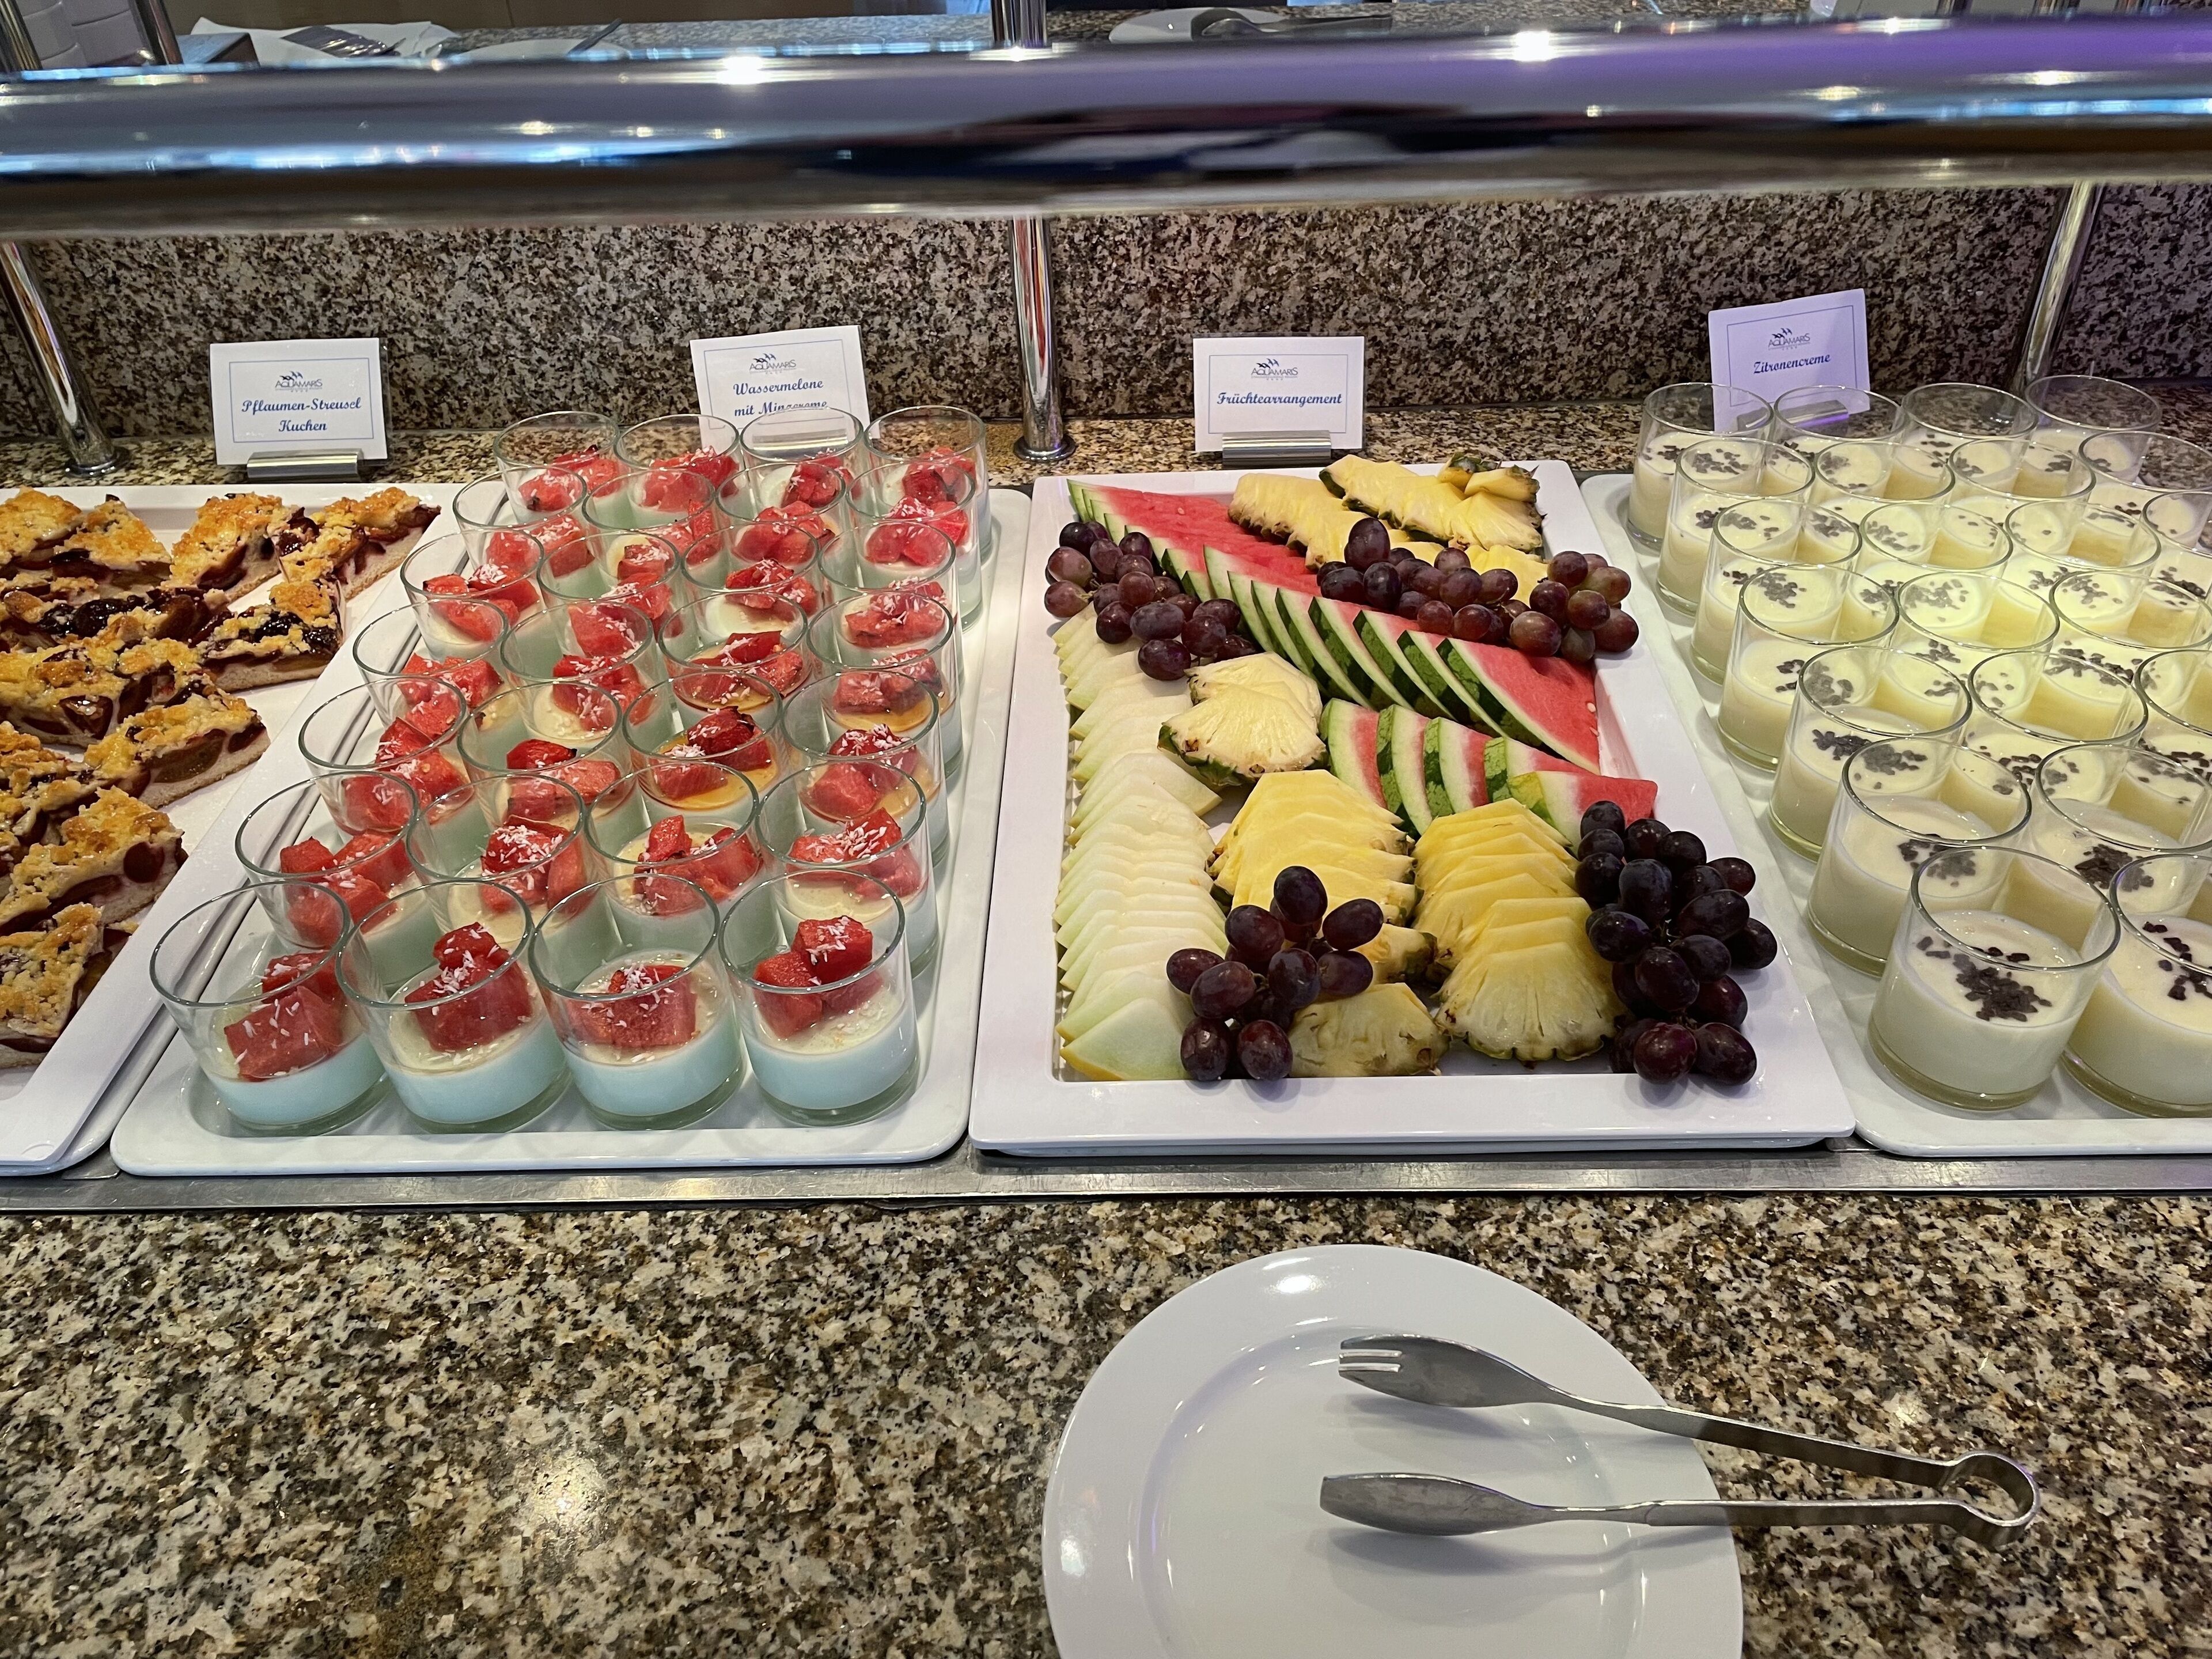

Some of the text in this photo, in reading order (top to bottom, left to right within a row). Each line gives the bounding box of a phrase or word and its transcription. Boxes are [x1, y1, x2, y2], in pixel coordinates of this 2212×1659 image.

[1753, 354, 1831, 374] Zitronencreme
[733, 378, 824, 395] Wassermelone
[241, 397, 362, 415] Pflaumen-Streusel
[1217, 392, 1342, 408] Früchtearrangement
[734, 406, 755, 416] mit
[278, 419, 327, 432] Kuchen
